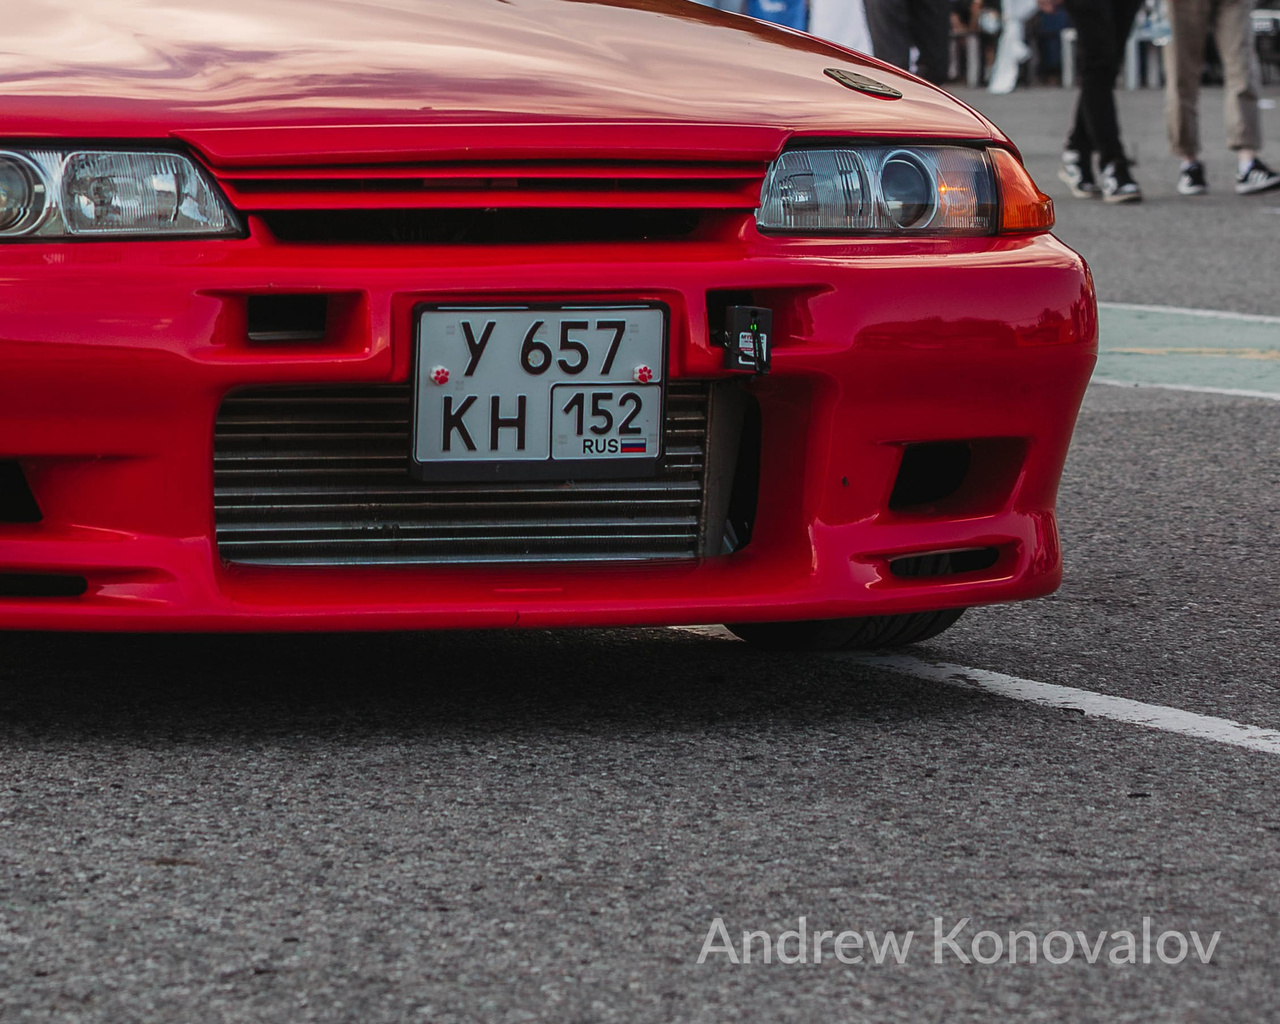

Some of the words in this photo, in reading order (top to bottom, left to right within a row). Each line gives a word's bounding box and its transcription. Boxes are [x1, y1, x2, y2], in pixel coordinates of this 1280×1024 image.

[521, 320, 627, 376] 657
[562, 392, 642, 435] 152
[583, 438, 619, 454] RUS
